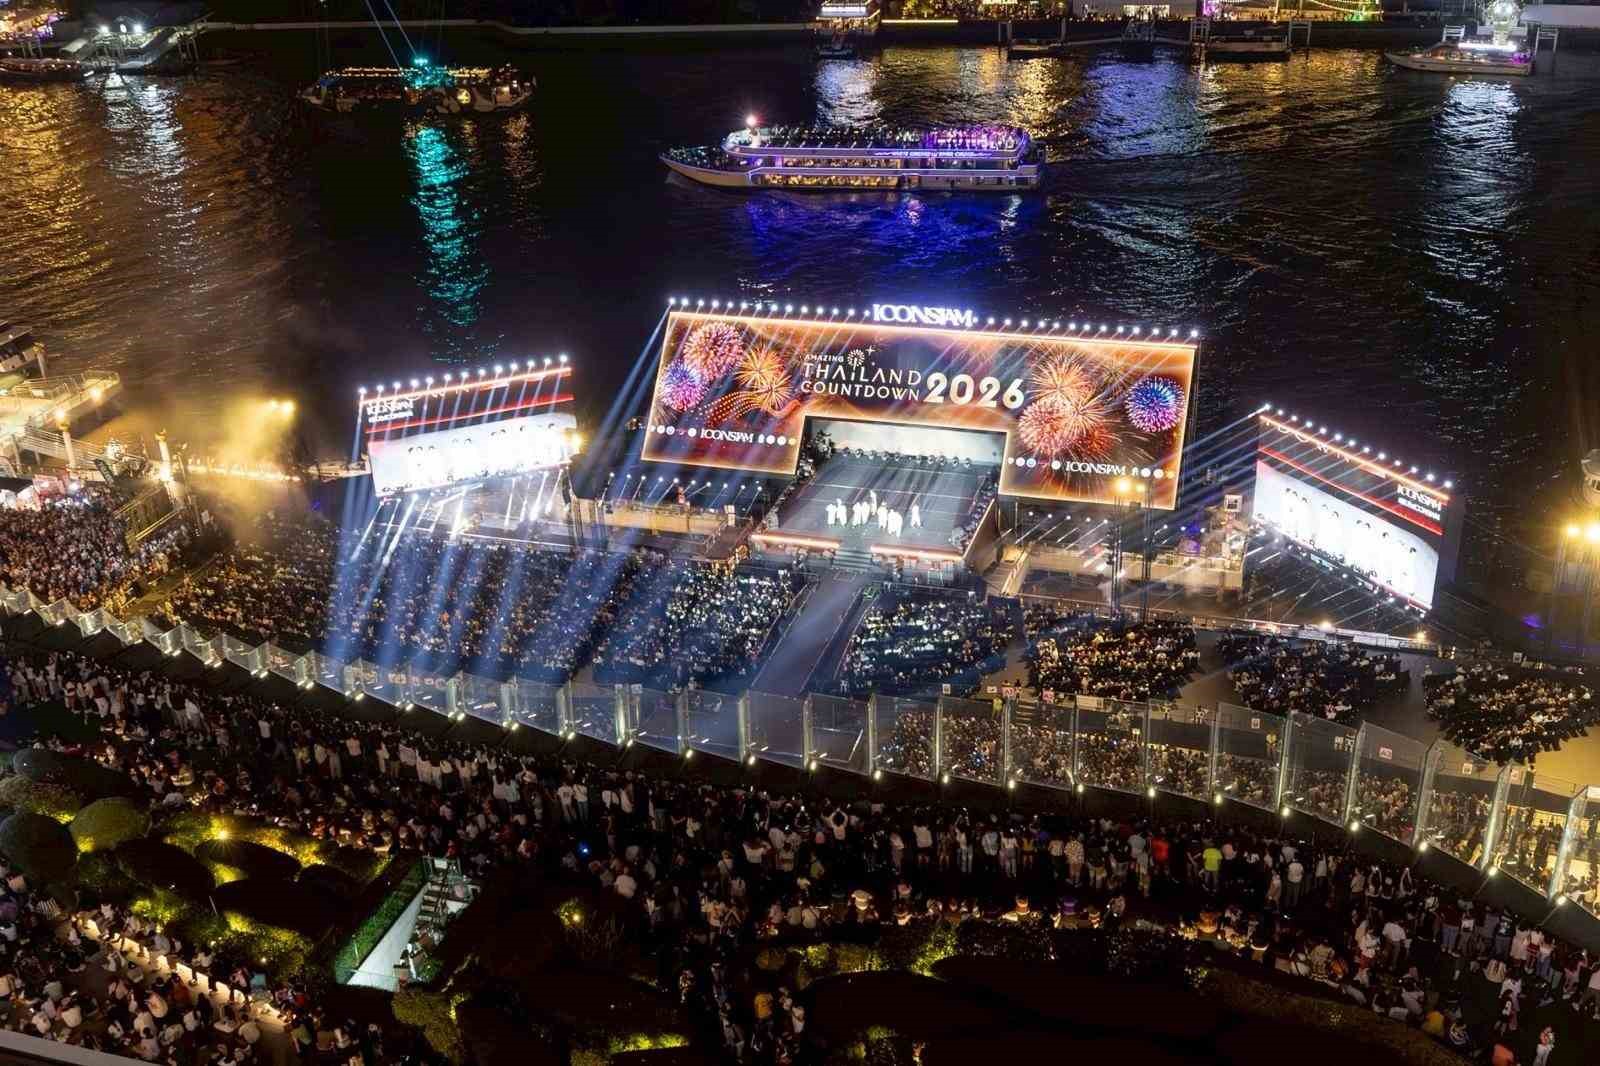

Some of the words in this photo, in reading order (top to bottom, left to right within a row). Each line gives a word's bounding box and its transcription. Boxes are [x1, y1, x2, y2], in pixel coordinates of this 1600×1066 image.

[872, 303, 974, 327] ICONSIAM
[804, 353, 845, 363] AMAZING
[801, 380, 920, 401] COUNTDOWN
[922, 371, 1025, 409] 2026
[701, 427, 754, 443] ICONSIAM
[1065, 460, 1127, 476] ICONSIAM
